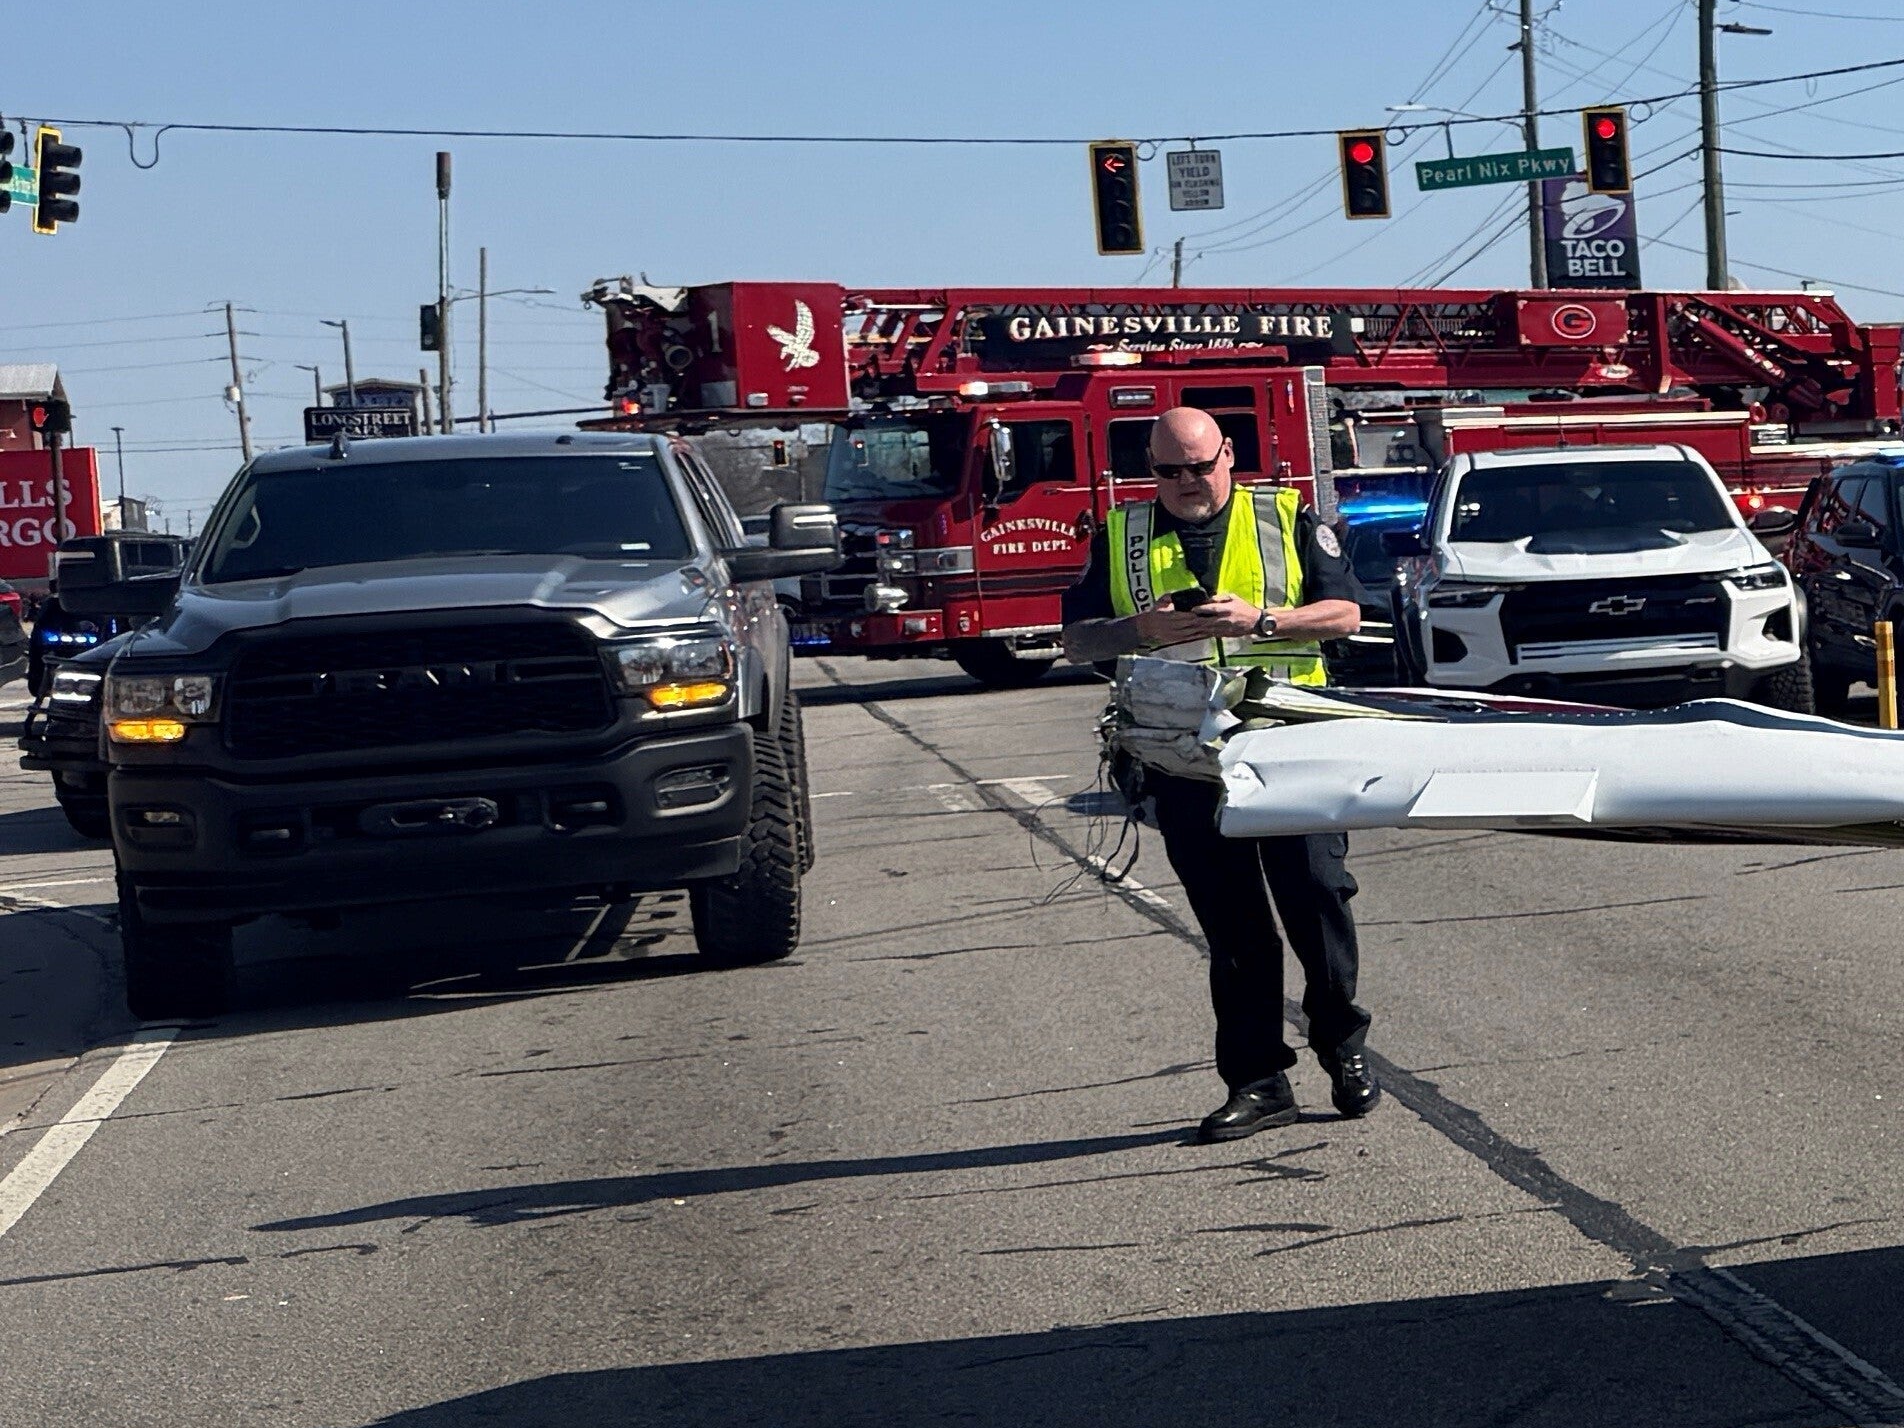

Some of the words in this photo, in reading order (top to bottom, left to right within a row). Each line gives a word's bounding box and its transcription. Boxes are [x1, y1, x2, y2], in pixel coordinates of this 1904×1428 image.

[1420, 163, 1472, 185] Pearl
[1478, 161, 1511, 179] Nix
[1517, 157, 1571, 175] Pkwy
[1560, 239, 1626, 258] TACO
[1567, 259, 1627, 277] BELL
[1008, 315, 1241, 341] GAINESVILLE
[1258, 315, 1333, 339] FIRE
[311, 413, 411, 426] LONGSTREET
[993, 542, 1027, 555] FIRE
[1032, 539, 1072, 553] DEPT.
